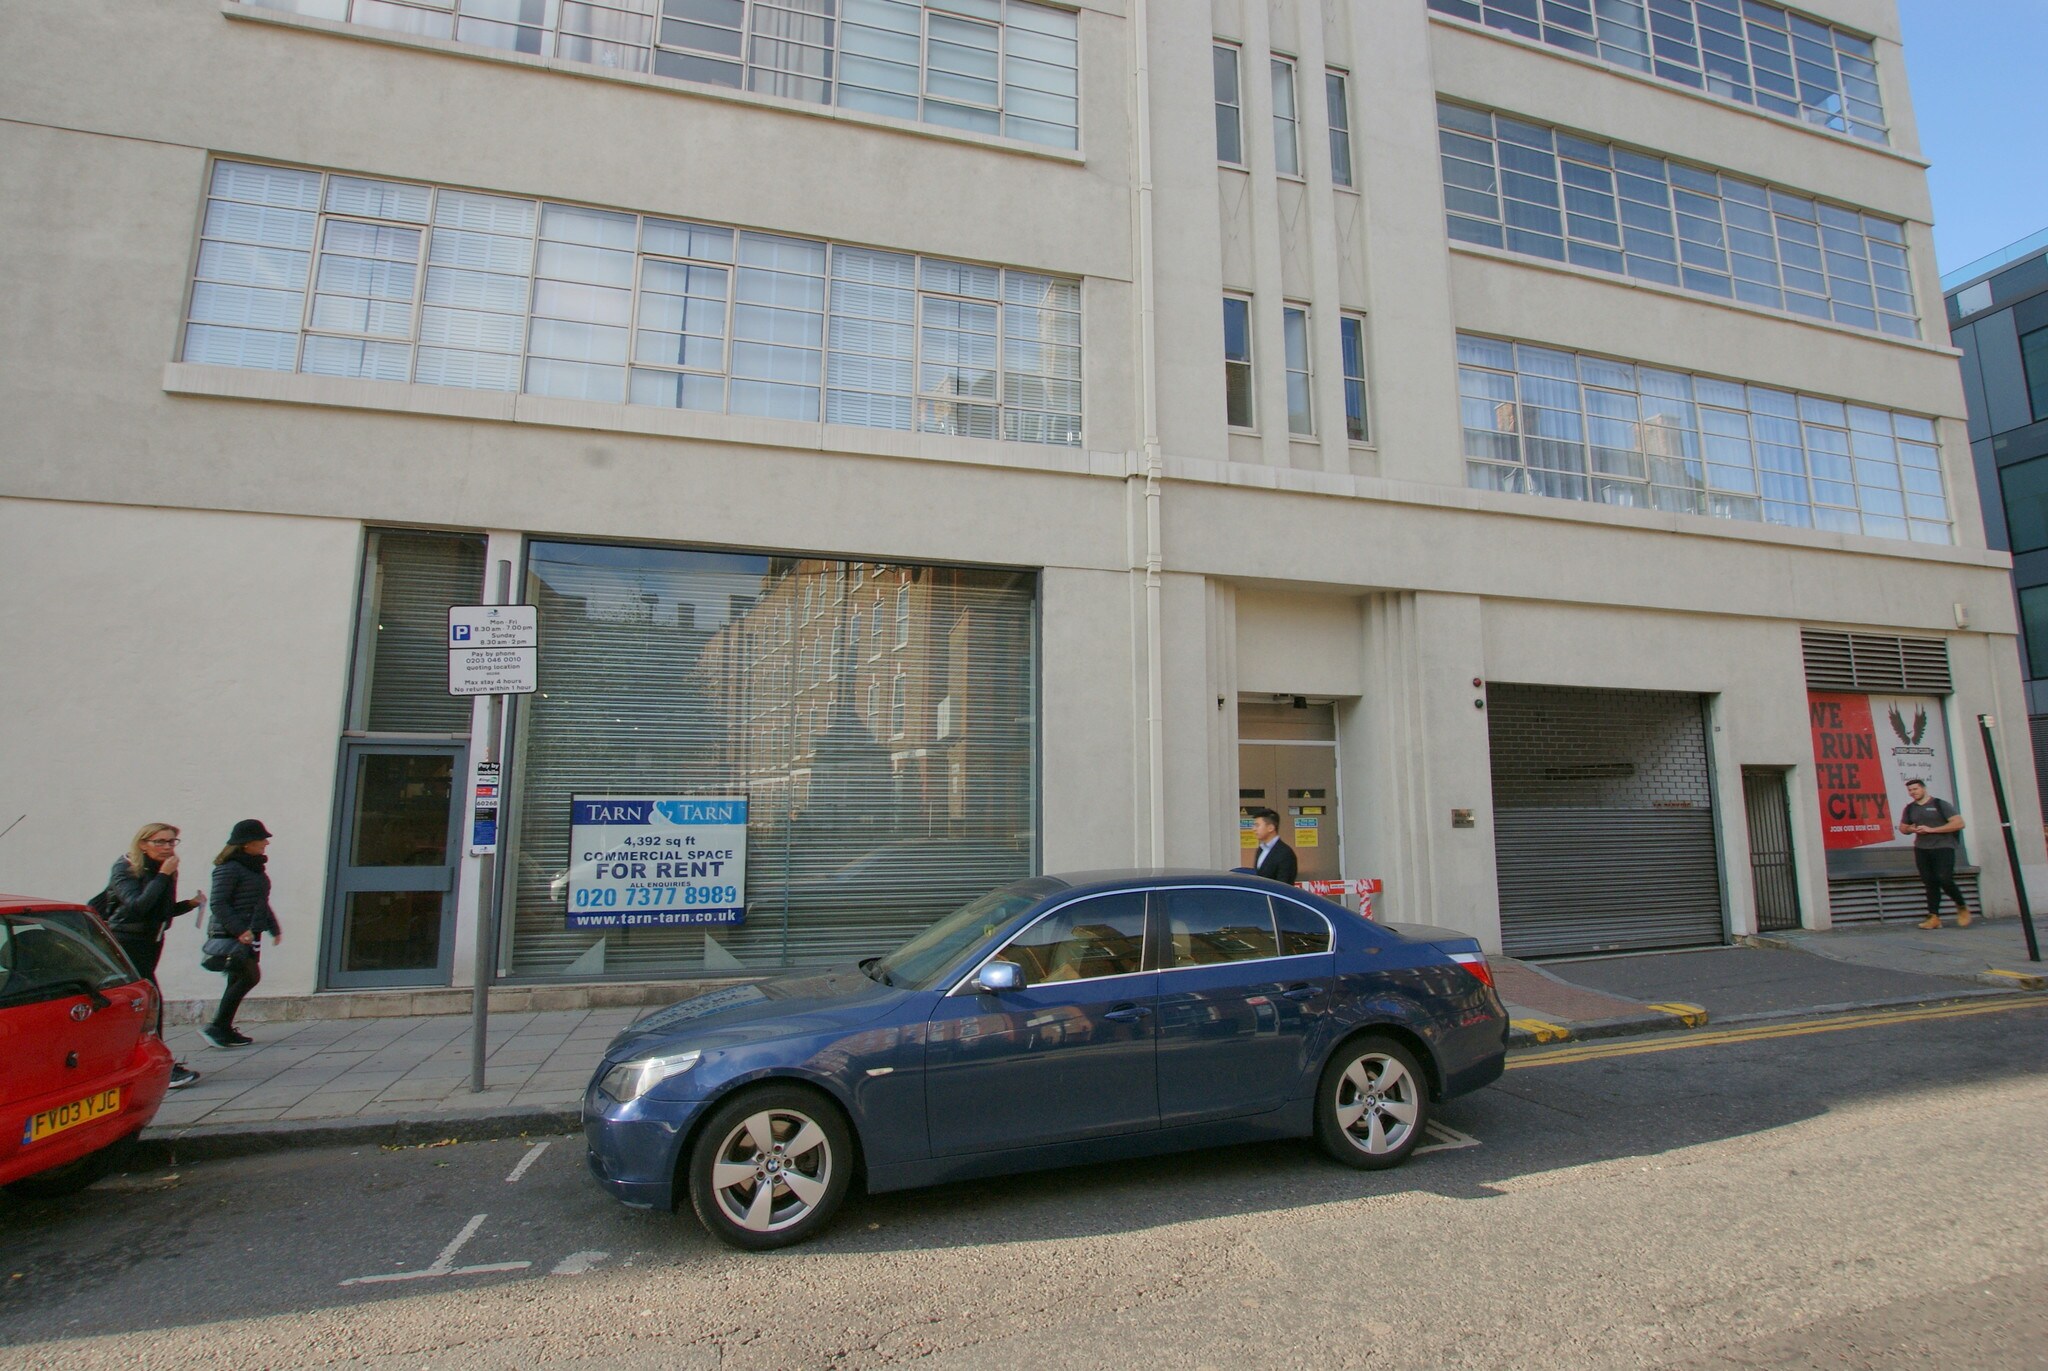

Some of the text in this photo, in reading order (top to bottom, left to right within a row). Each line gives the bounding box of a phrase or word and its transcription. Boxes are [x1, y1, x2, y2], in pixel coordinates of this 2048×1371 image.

[456, 626, 468, 640] P
[1820, 733, 1873, 759] RUN
[1816, 763, 1861, 789] THE
[586, 804, 641, 821] TARN
[680, 804, 733, 820] TARN
[1828, 793, 1888, 820] CITY
[624, 836, 696, 848] 4,392 sq ft
[584, 850, 733, 861] COMMERCIAL SPACE
[596, 862, 724, 879] FOR RENT
[576, 886, 736, 907] 020 7377 8989
[577, 910, 736, 925] www.tarn-tarn.co.uk
[35, 1090, 116, 1135] FV03 YJC
